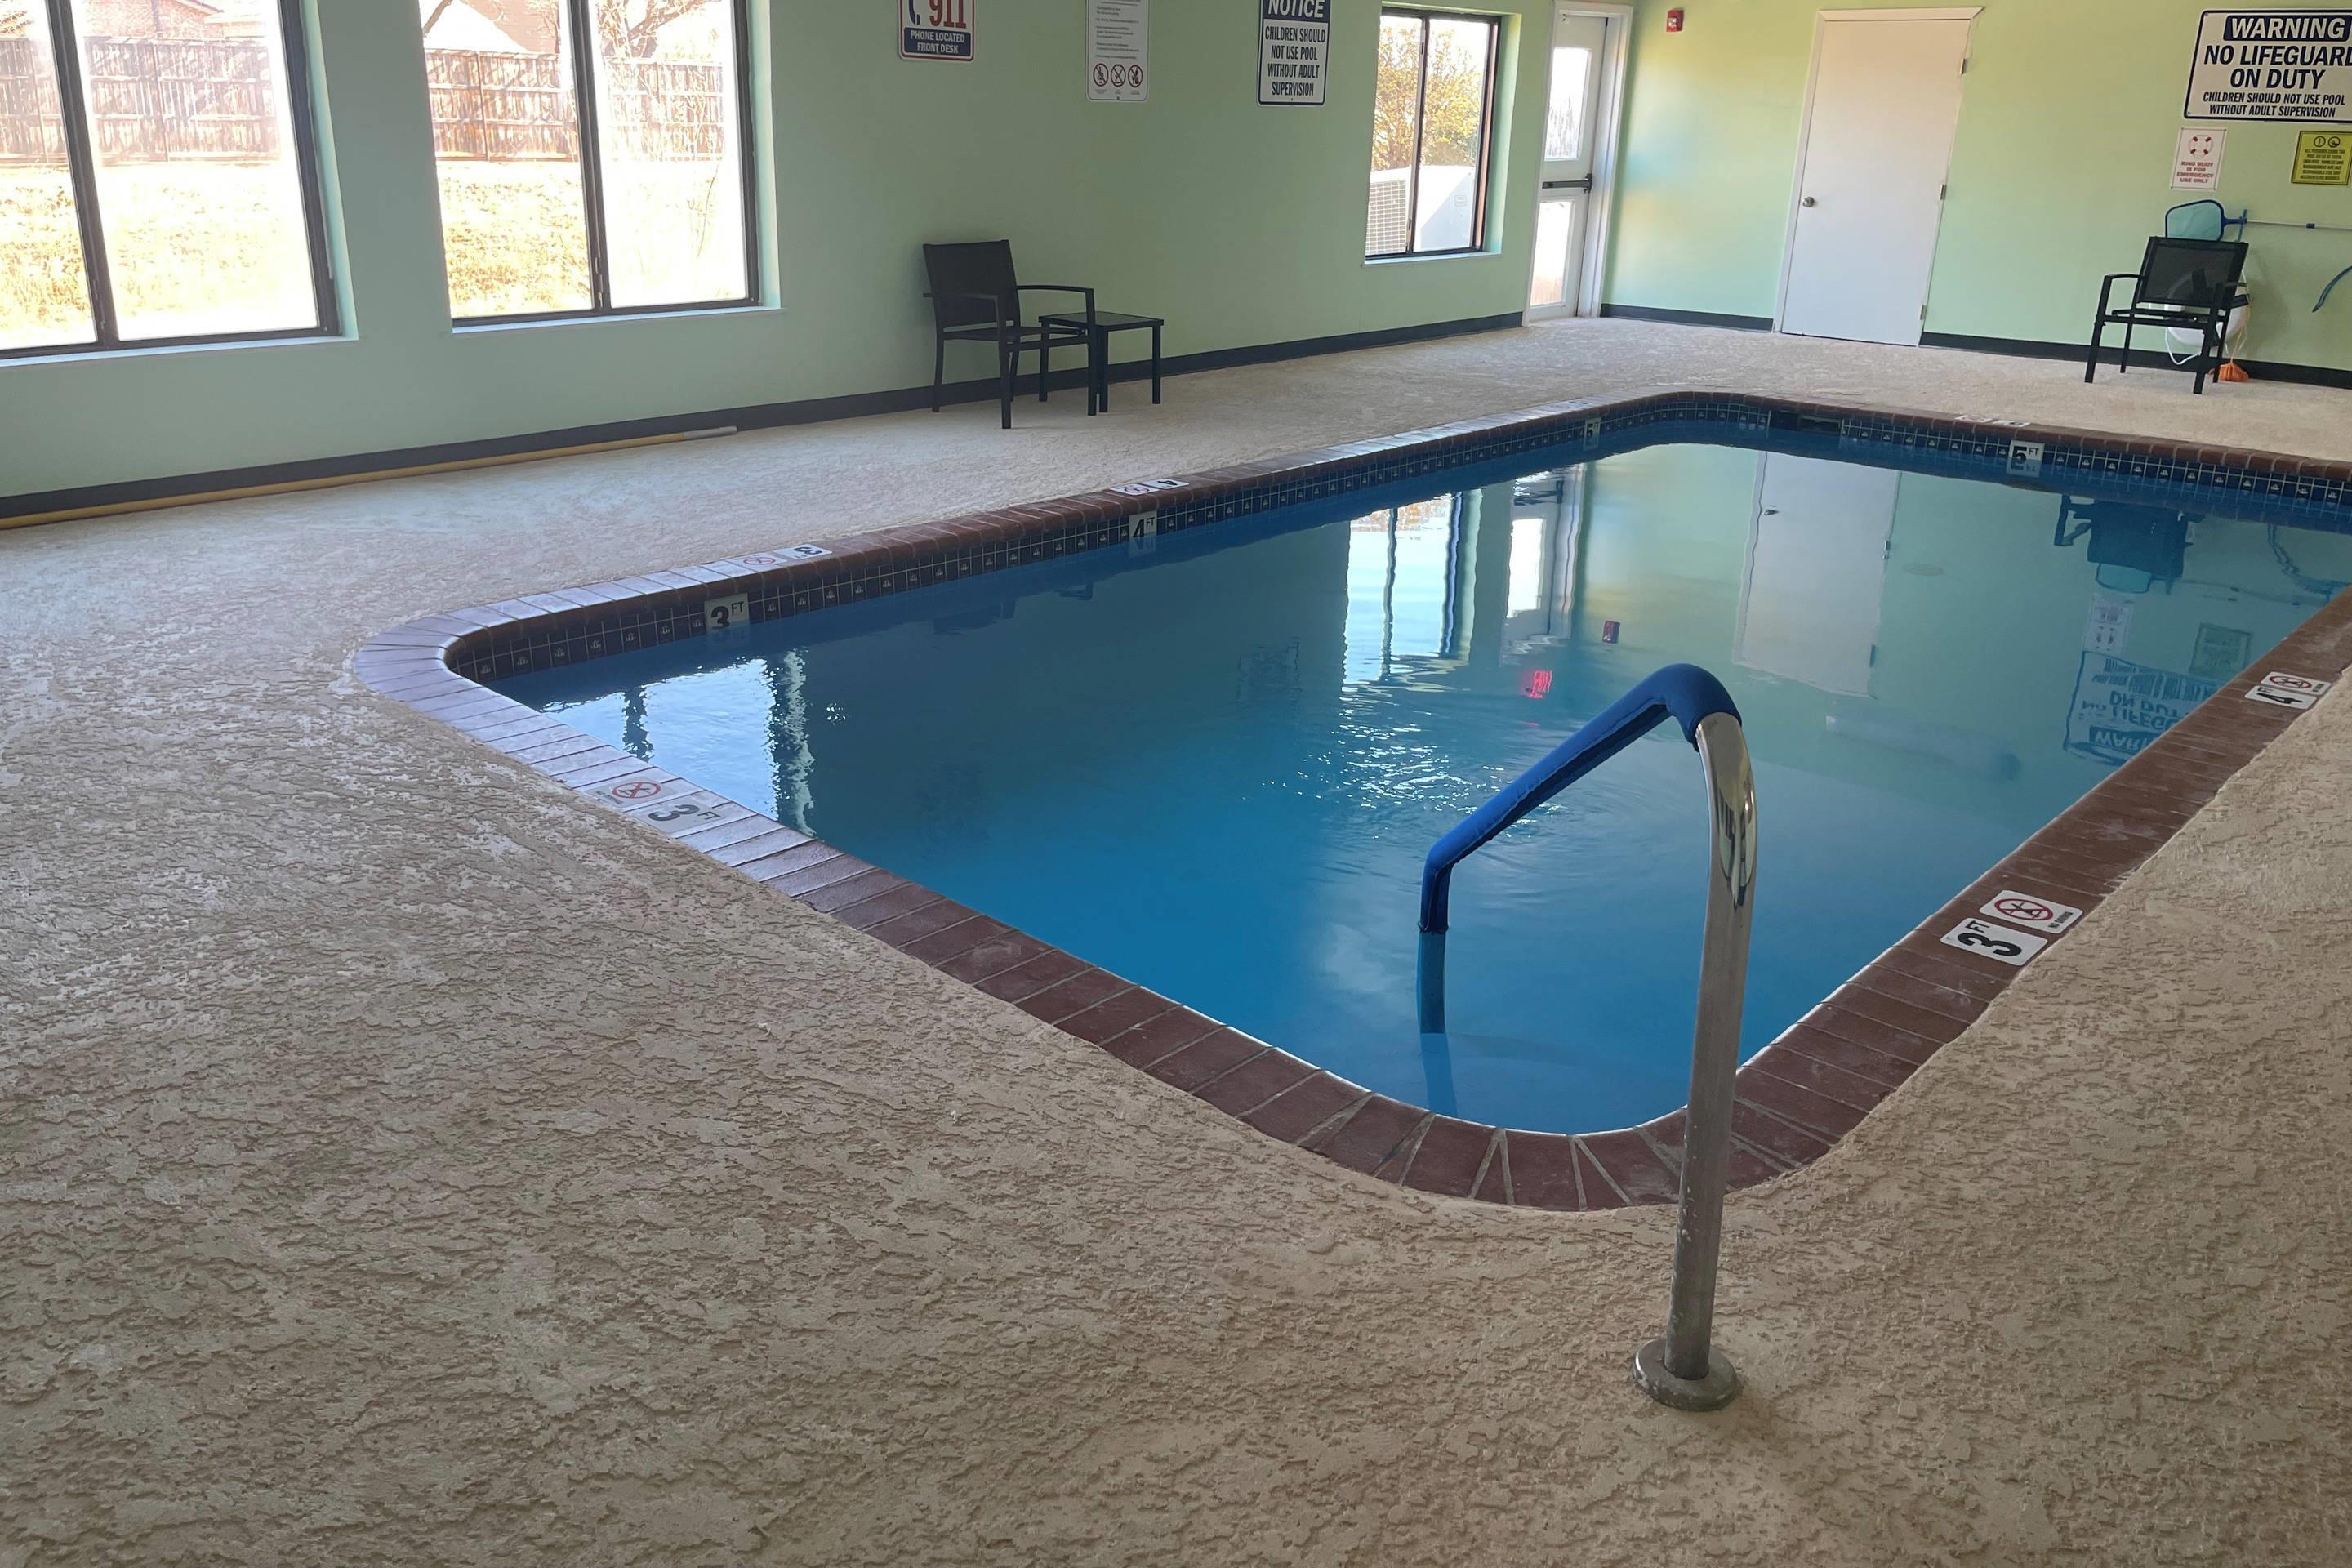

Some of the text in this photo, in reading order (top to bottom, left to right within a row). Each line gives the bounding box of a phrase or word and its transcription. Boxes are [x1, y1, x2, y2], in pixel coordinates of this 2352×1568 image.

[929, 0, 967, 28] 911
[1267, 0, 1325, 18] NOTICE
[1265, 26, 1325, 42] CHILDREN SHOULD
[2231, 17, 2345, 39] WARNING
[911, 30, 965, 43] PHONE LOCATED
[917, 42, 959, 53] FRONT DESK
[1272, 45, 1317, 60] NOT USE POOL
[2203, 45, 2234, 65] NO
[1267, 63, 1320, 78] WITHOUT ADULT
[2230, 68, 2326, 90] ON DUTY
[1272, 82, 1314, 96] SUPERVISION
[2203, 91, 2345, 105] CHILDREN SHOULD NOT USE POOL
[2209, 105, 2336, 118] WITHOUT ADULT SUPERVISION
[2012, 446, 2039, 463] 5 FT
[1146, 516, 1155, 528] FT
[711, 601, 744, 629] 3 FT
[648, 804, 721, 821] 3 FT
[1958, 920, 2022, 956] 3 FT
